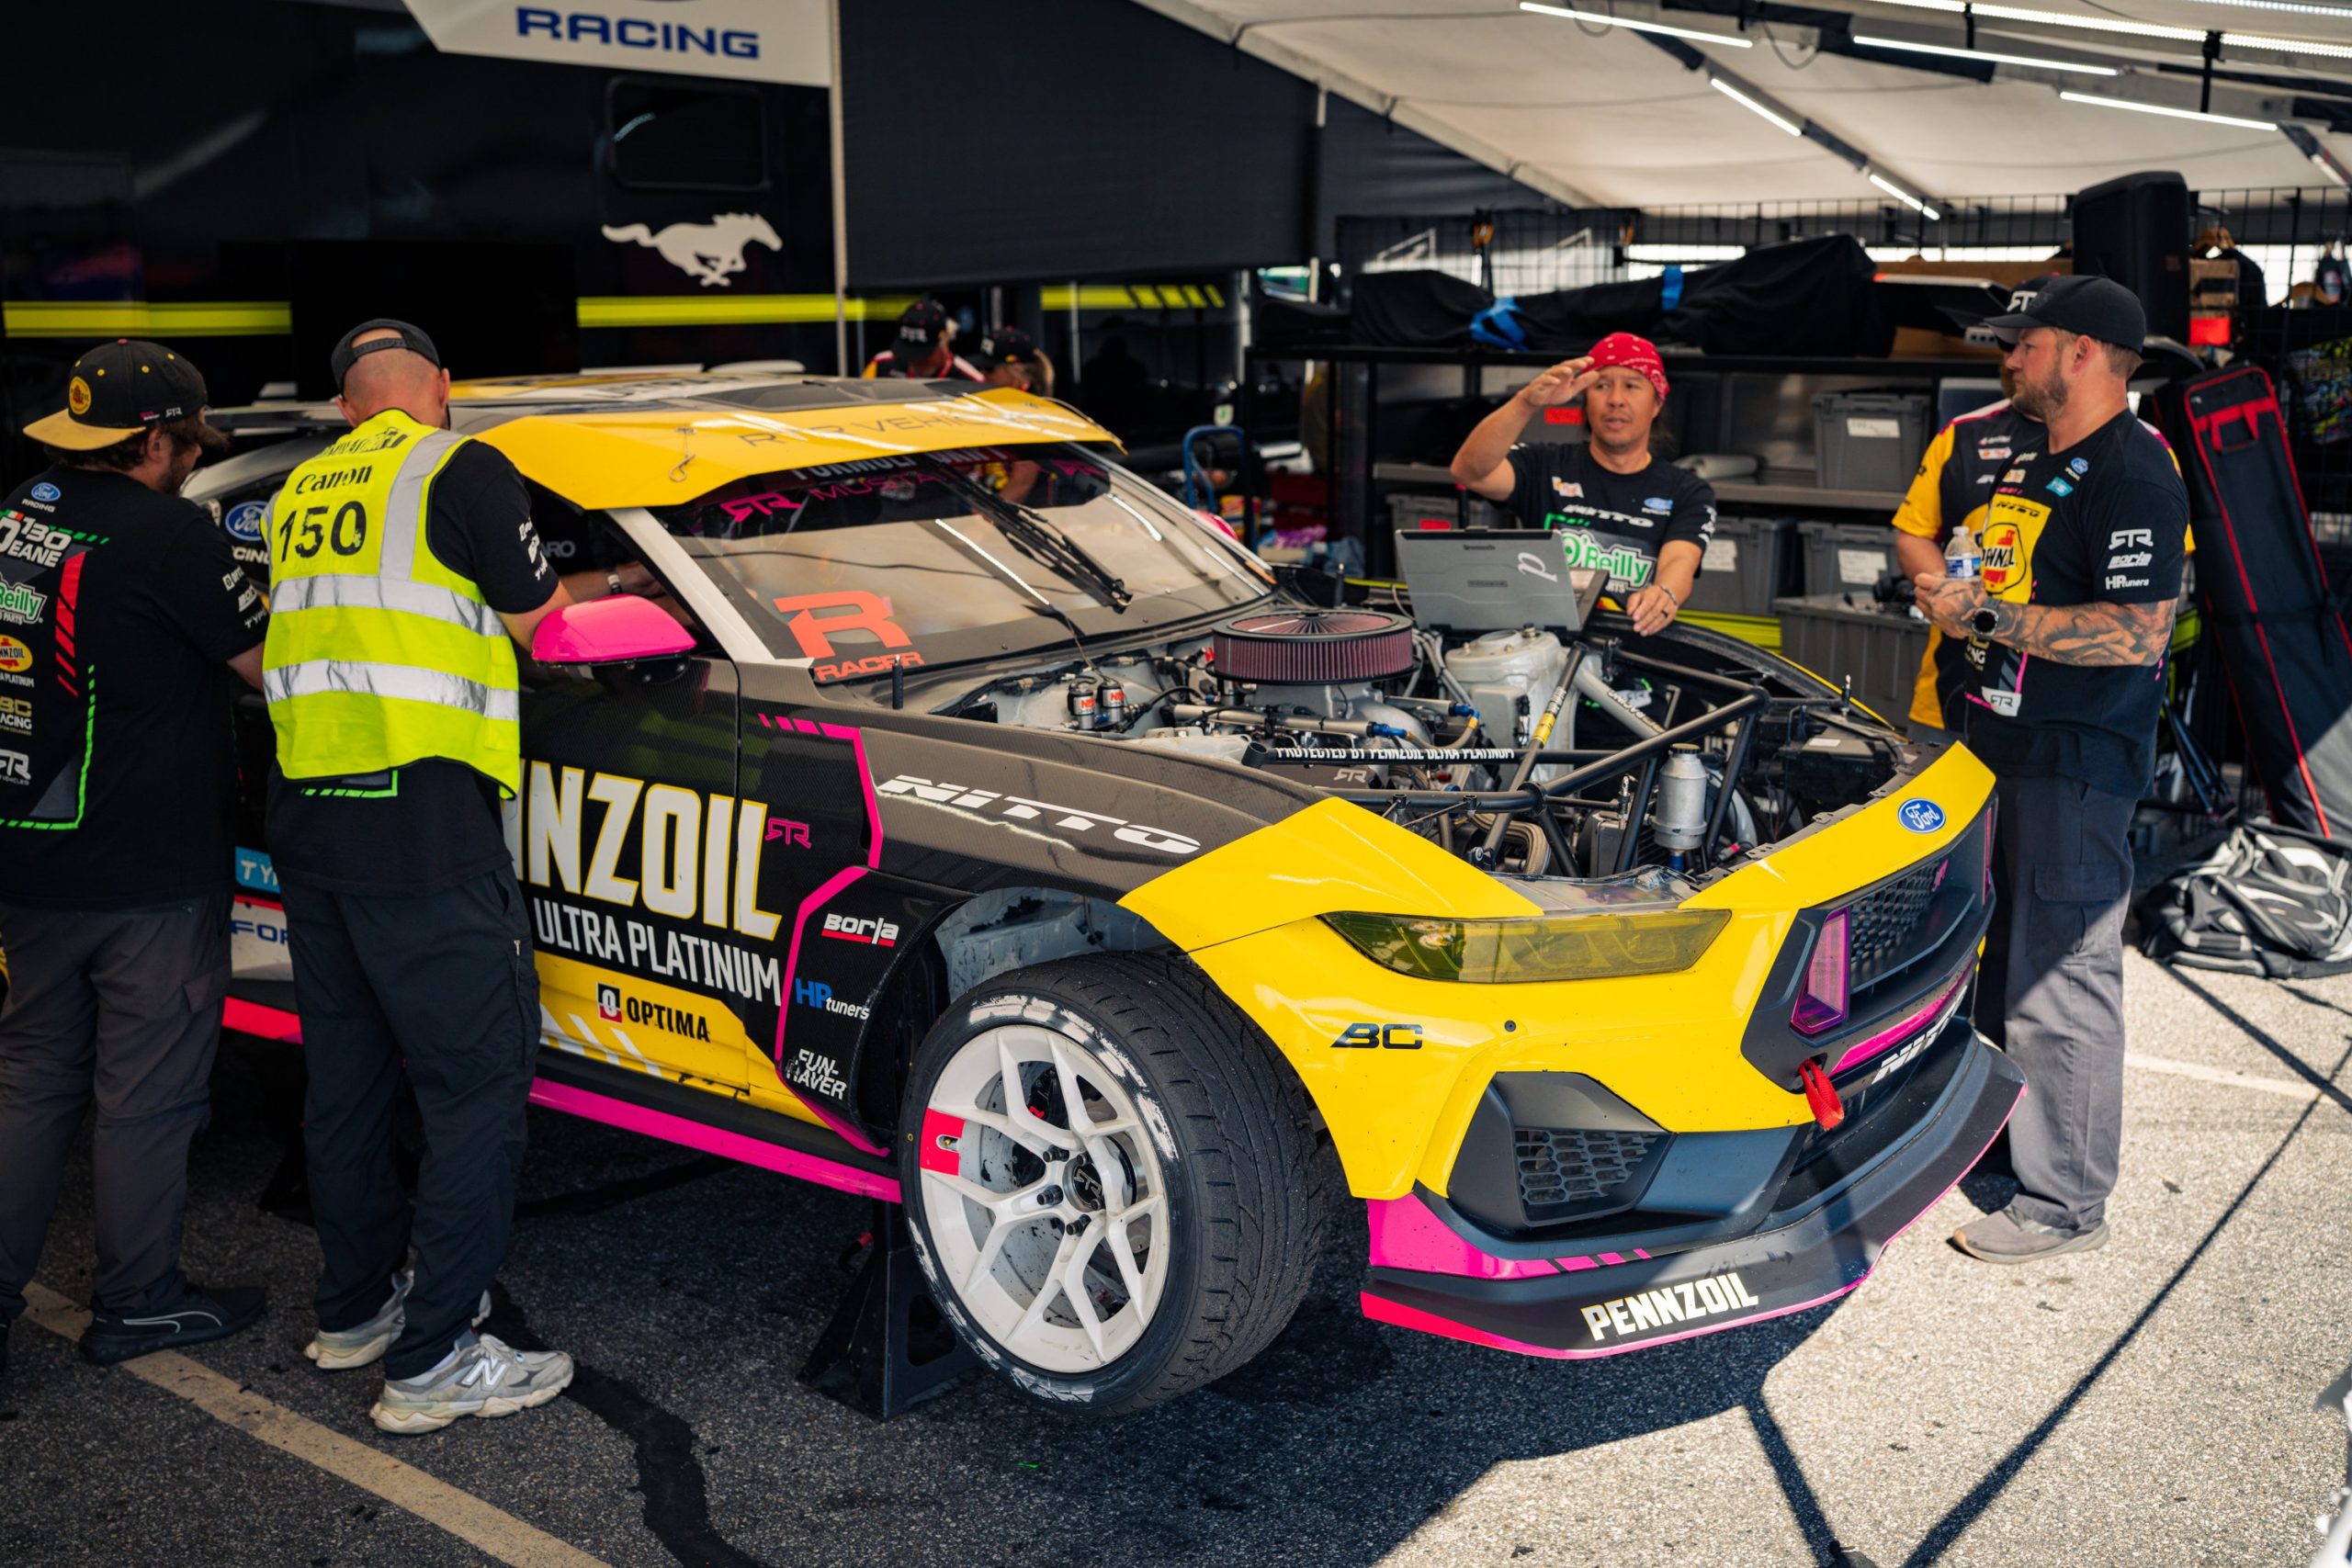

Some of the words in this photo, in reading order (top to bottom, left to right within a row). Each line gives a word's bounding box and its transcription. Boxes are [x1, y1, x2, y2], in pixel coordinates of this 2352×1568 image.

[515, 6, 760, 60] RACING
[2007, 290, 2039, 312] RT
[296, 464, 373, 495] Canon
[21, 498, 56, 513] RACING
[720, 492, 803, 524] RTR
[20, 516, 73, 551] 130
[279, 500, 368, 563] 150
[2109, 528, 2154, 550] RTR
[0, 585, 39, 618] Reilly
[813, 651, 926, 682] RACER
[0, 713, 32, 730] ACING
[1332, 768, 1367, 784] RTR
[878, 773, 1203, 855] NITTO
[1905, 804, 1940, 830] Ford
[502, 758, 783, 942] NZOIL
[764, 817, 812, 850] RTR
[533, 896, 626, 964] ULTRA
[627, 919, 782, 1007] PLATINUM
[627, 996, 711, 1043] OPTIMA
[1579, 1271, 1759, 1342] PENNZOIL
